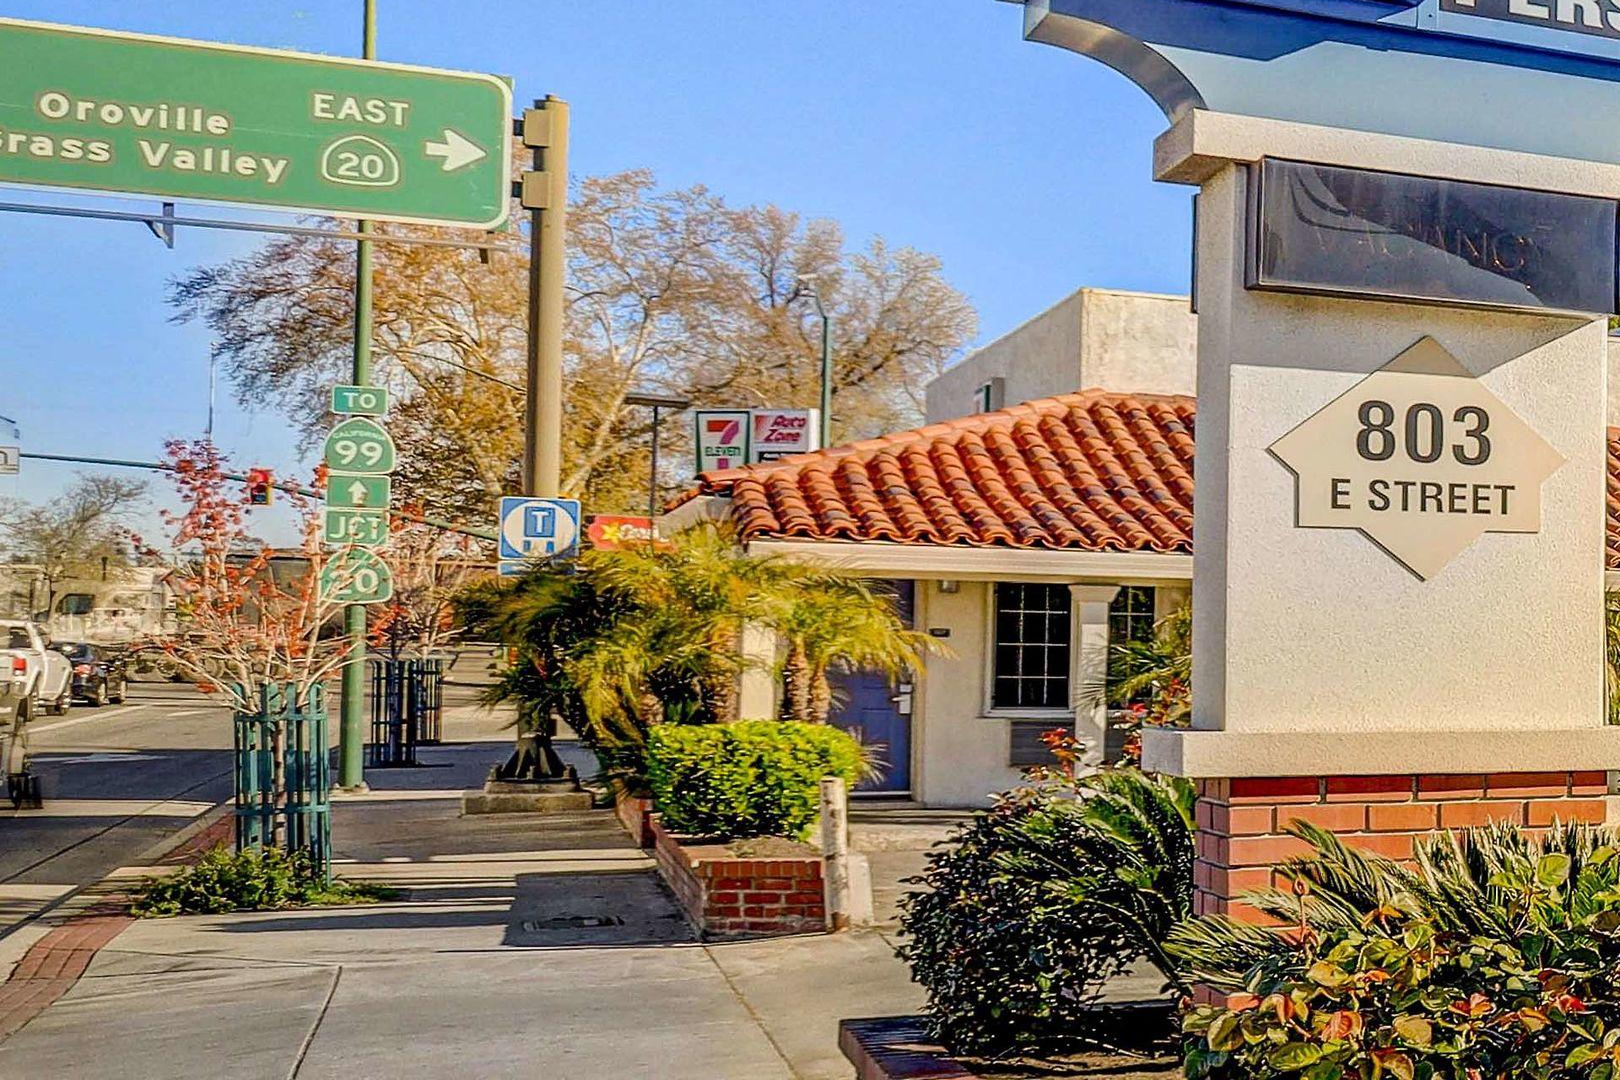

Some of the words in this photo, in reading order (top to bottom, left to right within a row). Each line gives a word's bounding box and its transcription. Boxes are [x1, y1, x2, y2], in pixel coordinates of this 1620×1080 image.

[38, 91, 230, 135] Oroville
[313, 93, 410, 126] EAST
[0, 129, 112, 163] rass
[138, 139, 289, 184] Valley
[336, 151, 385, 180] 20
[342, 392, 377, 409] TO
[707, 419, 740, 445] 7
[1356, 400, 1492, 466] 803
[334, 440, 383, 467] 99
[1330, 477, 1352, 510] E
[1367, 479, 1516, 516] STREET
[328, 516, 382, 540] JCT
[328, 567, 380, 594] 20
